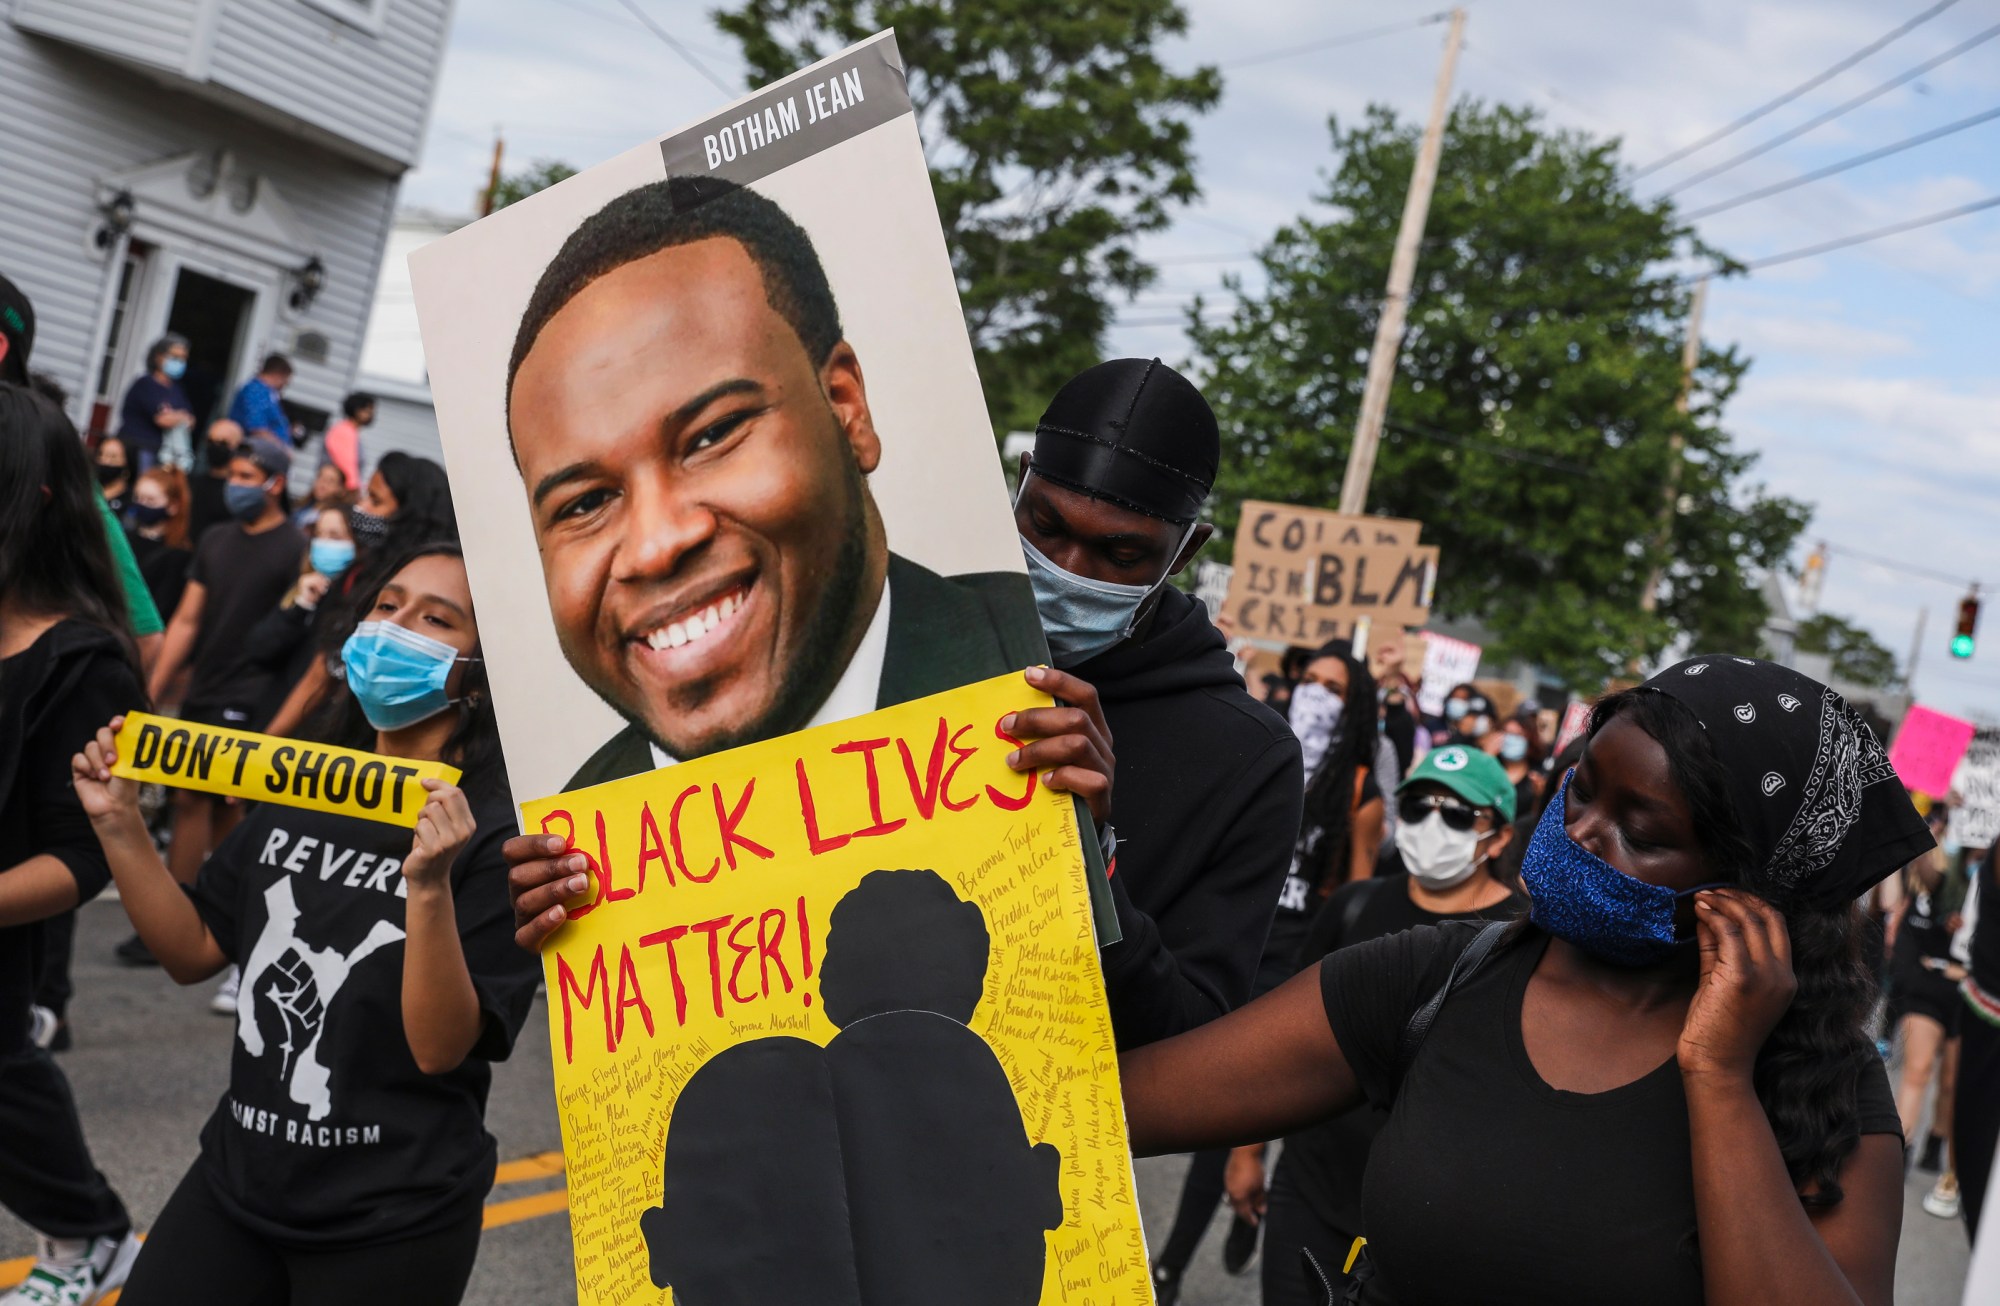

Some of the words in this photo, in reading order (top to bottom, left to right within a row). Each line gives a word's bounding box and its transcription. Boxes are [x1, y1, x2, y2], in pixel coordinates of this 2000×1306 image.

[703, 96, 801, 170] BOTHAM
[805, 67, 865, 125] JEAN
[1315, 553, 1428, 608] BLM
[1238, 597, 1356, 640] CRIM
[132, 723, 261, 787] DON'T
[265, 746, 419, 813] SHOOT
[540, 776, 775, 922] BLACK
[794, 715, 1039, 857] LIVES
[957, 849, 1006, 896] Breonna
[1003, 822, 1042, 855] Taylor
[1068, 855, 1086, 894] Keller
[989, 901, 1032, 936] Freddie
[1032, 883, 1060, 908] Gray
[1029, 905, 1064, 938] Gurley
[554, 895, 815, 1065] MATTER!
[986, 969, 1001, 1005] Walter
[1081, 950, 1105, 1009] Hamilton
[769, 1012, 810, 1032] Marshall
[1005, 997, 1044, 1022] Brandon
[688, 1036, 713, 1062] Hall
[986, 1008, 1041, 1044] Ahmaud
[1042, 1026, 1090, 1057] Arbery
[625, 1064, 654, 1099] Alfred
[1030, 1048, 1054, 1086] Grant
[1056, 1065, 1090, 1085] Botham
[1092, 1055, 1115, 1081] Jean
[560, 1083, 591, 1110] George
[592, 1063, 619, 1087] Floyd
[1021, 1086, 1041, 1122] Oscar
[286, 1119, 380, 1147] RACISM
[575, 1132, 607, 1158] James
[611, 1122, 640, 1139] Perez
[1103, 1097, 1124, 1148] Stewart
[567, 1148, 608, 1178] Kendrick
[610, 1138, 642, 1168] Johnson
[613, 1180, 640, 1202] Tamir
[642, 1171, 660, 1189] Rice
[608, 1237, 646, 1275] Mohamed
[1054, 1238, 1092, 1271] Kendra
[1092, 1218, 1124, 1257] James
[595, 1274, 626, 1305] Kwame
[1098, 1257, 1130, 1284] Clark
